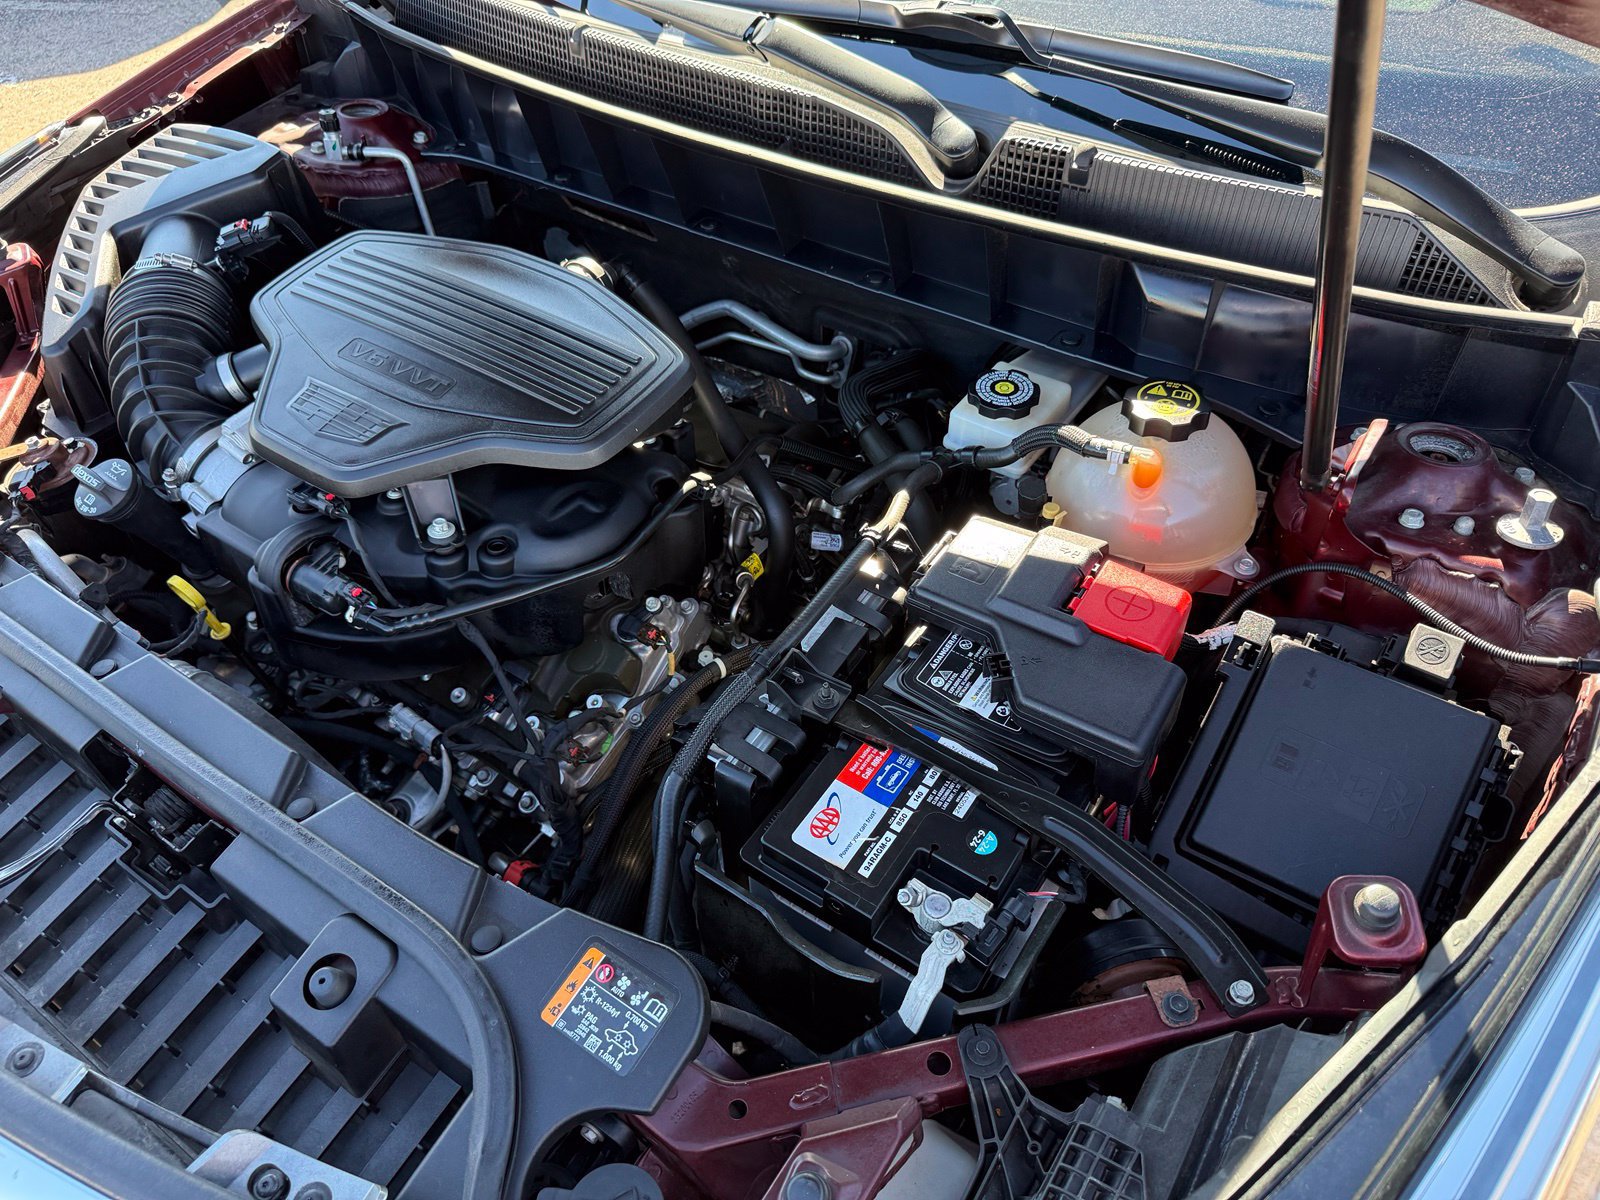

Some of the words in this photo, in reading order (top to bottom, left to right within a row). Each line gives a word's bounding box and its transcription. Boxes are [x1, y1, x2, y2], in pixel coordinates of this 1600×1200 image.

[351, 343, 390, 368] V6
[390, 359, 450, 392] VVT
[74, 466, 101, 488] dexos
[933, 633, 959, 664] DANGER/P
[862, 766, 874, 780] Call:
[930, 771, 938, 780] 80
[913, 791, 924, 803] 140
[811, 808, 840, 838] AAA
[896, 813, 908, 827] 850
[839, 841, 853, 858] Power
[852, 832, 861, 842] you
[969, 829, 987, 849] 6-24
[978, 835, 995, 854] A-24
[864, 836, 892, 872] 94RAGM-C
[611, 986, 625, 998] AUTO
[585, 1012, 598, 1024] PAG
[595, 998, 621, 1019] R-1234yf
[625, 1011, 642, 1025] 0.700
[639, 1022, 649, 1032] kg
[598, 1050, 616, 1065] 1.000
[612, 1061, 623, 1071] kg
